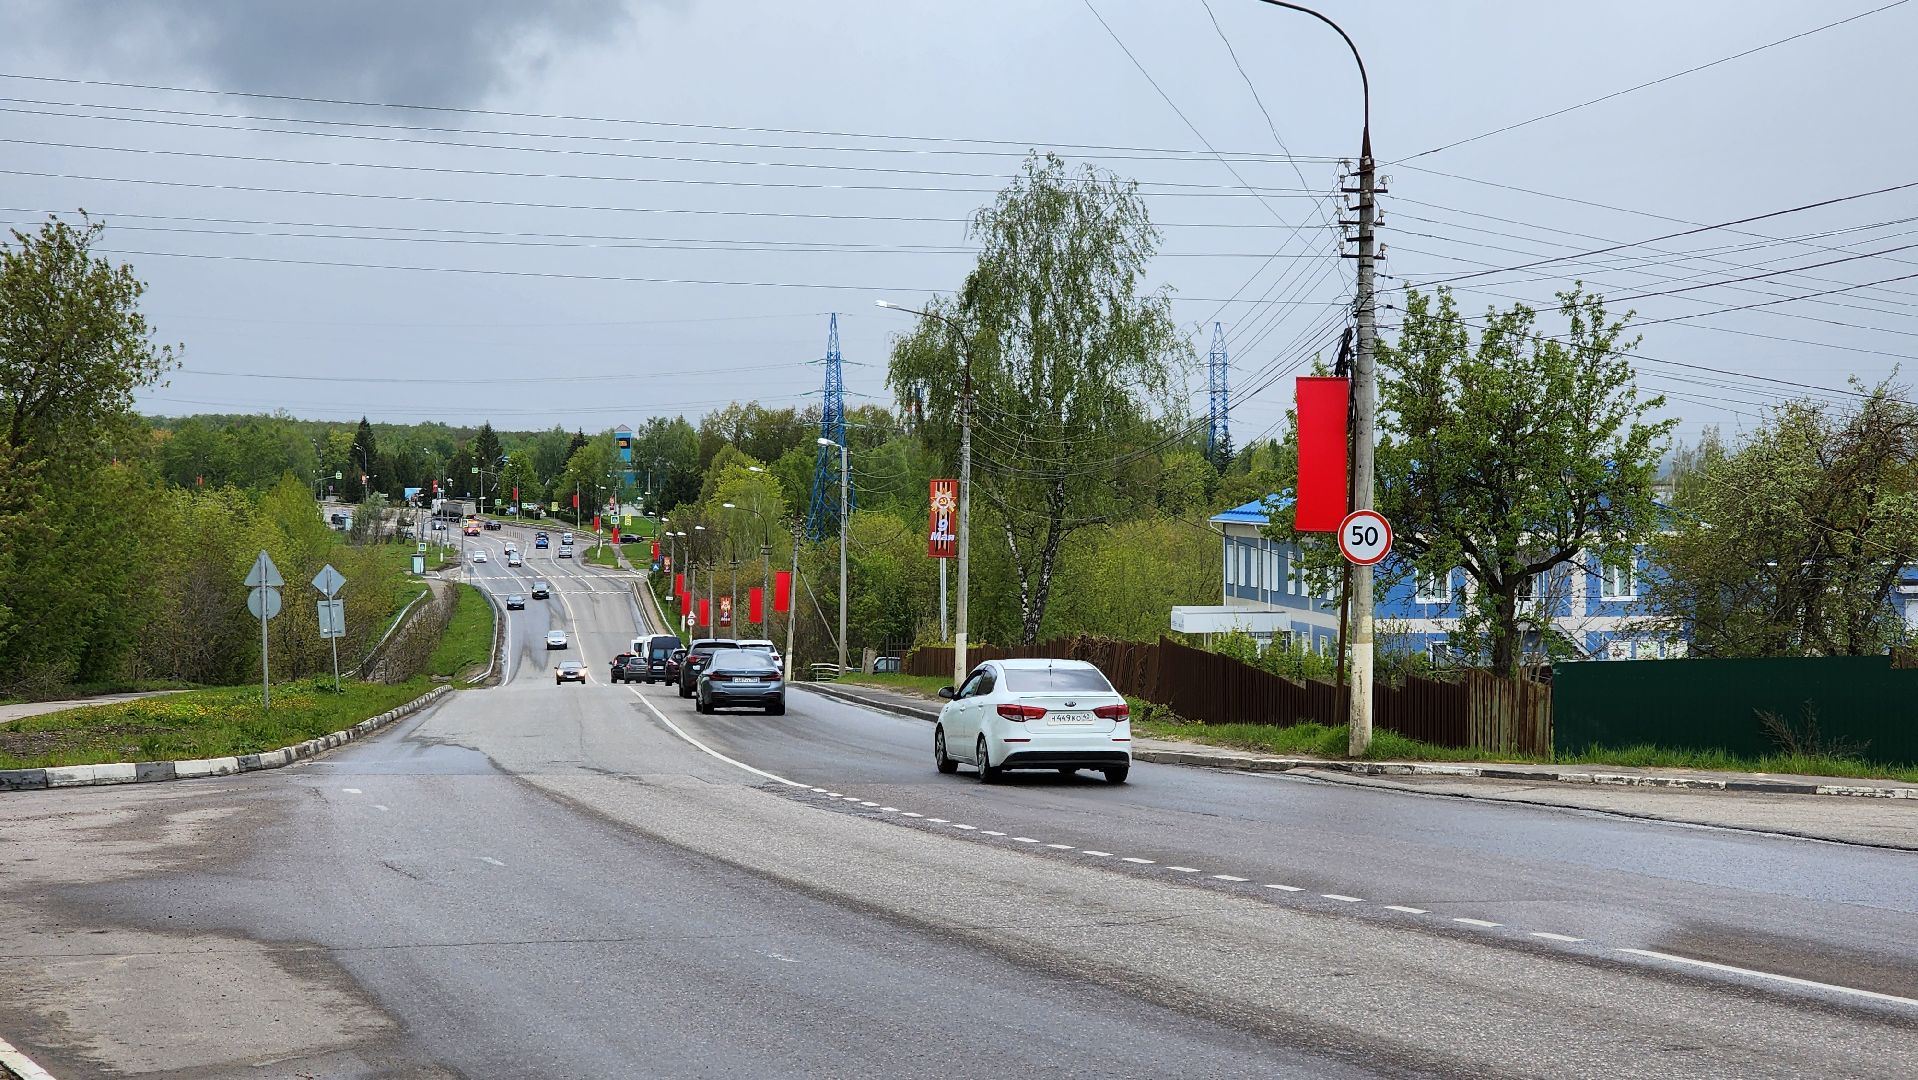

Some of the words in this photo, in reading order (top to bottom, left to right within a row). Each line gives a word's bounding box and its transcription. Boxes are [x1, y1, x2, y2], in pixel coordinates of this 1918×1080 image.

[937, 519, 948, 531] 9
[930, 532, 955, 541] Мая
[1351, 526, 1379, 546] 50
